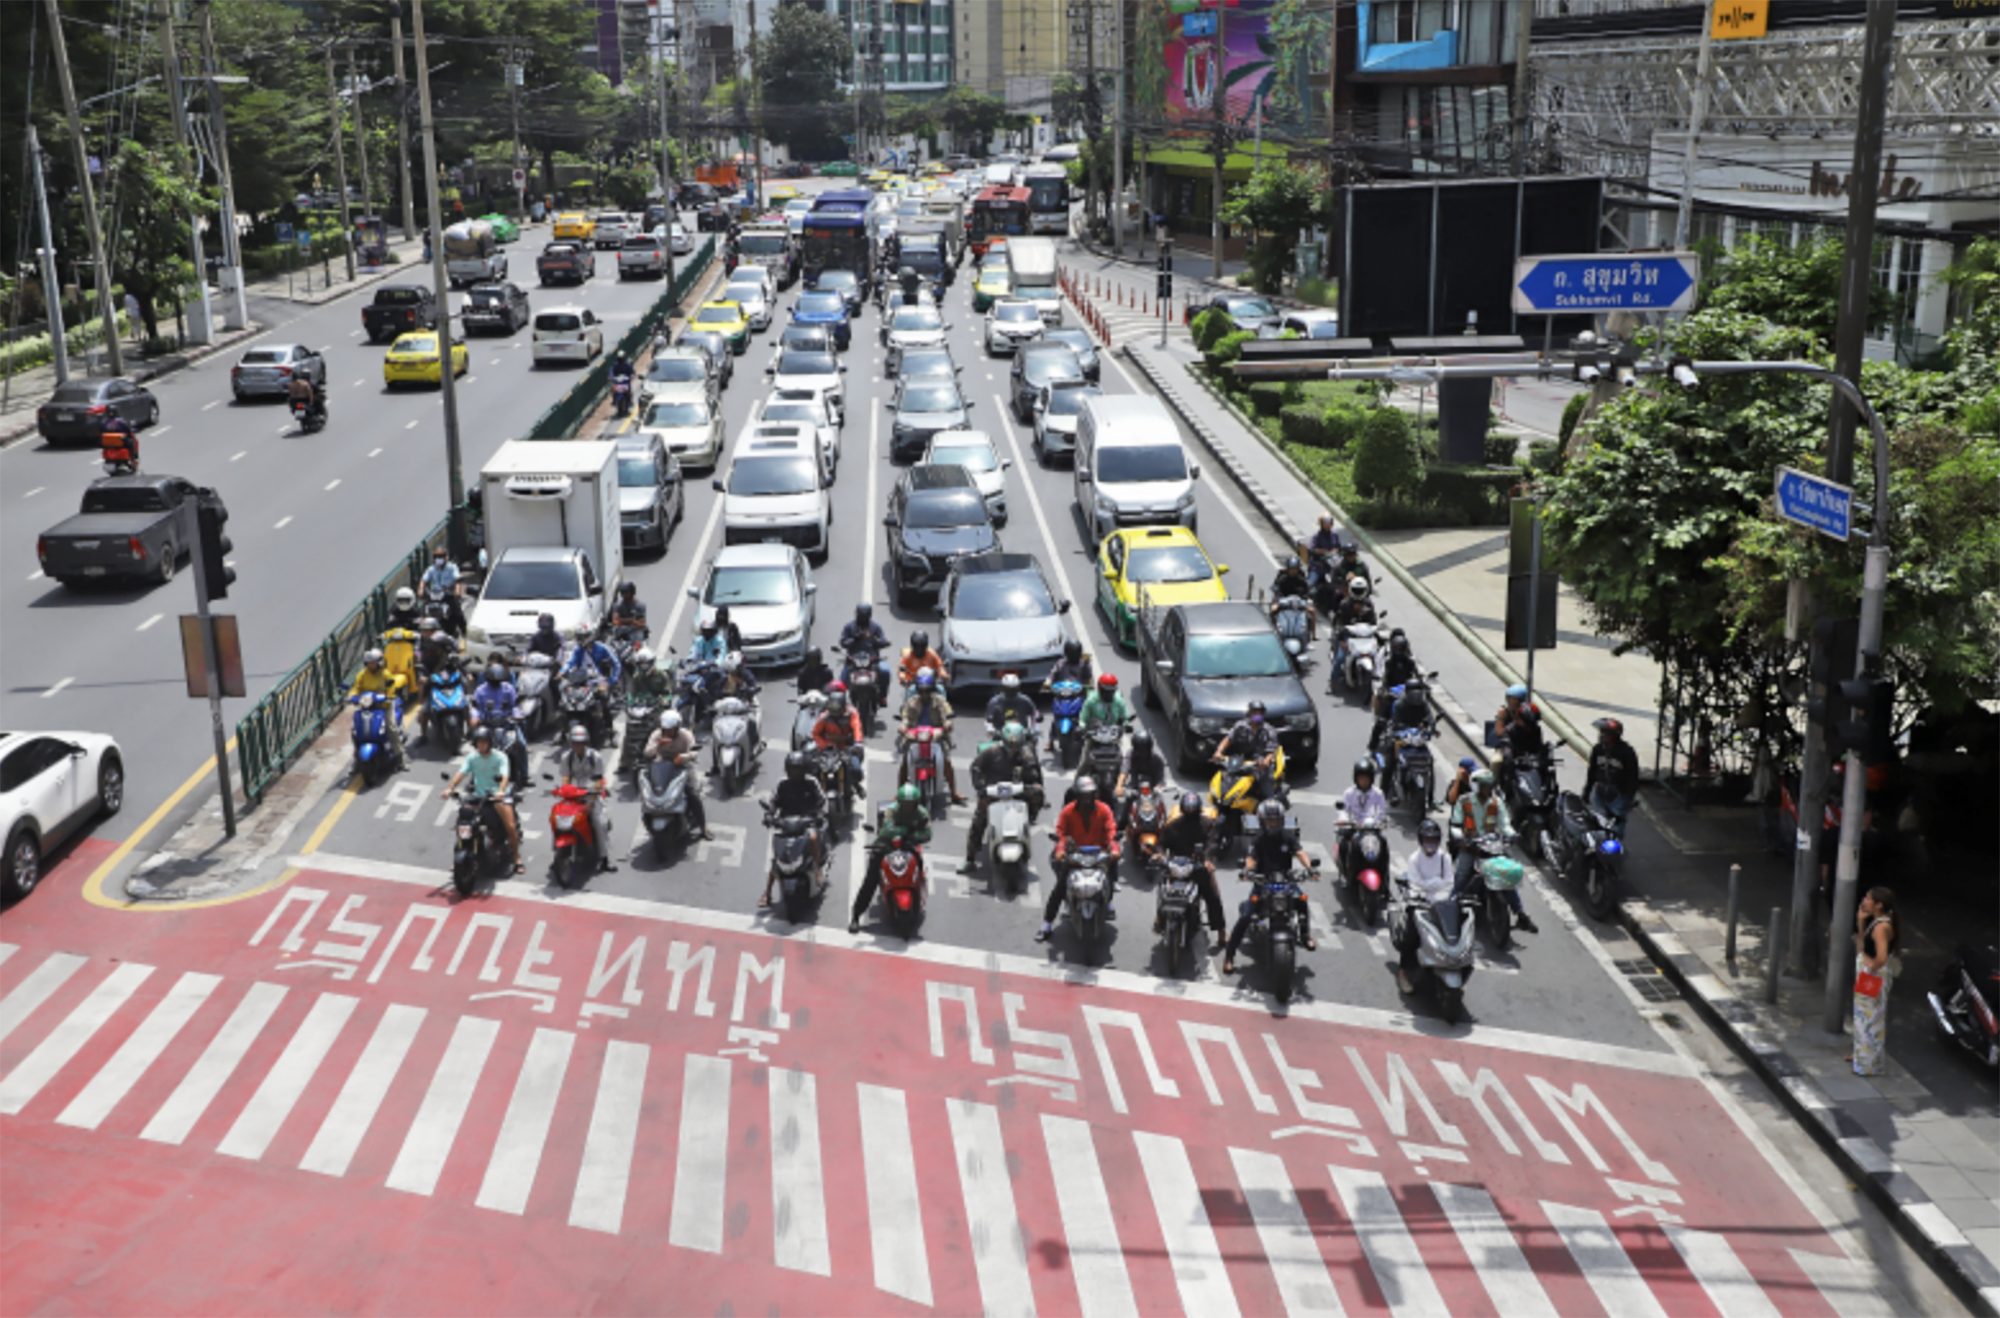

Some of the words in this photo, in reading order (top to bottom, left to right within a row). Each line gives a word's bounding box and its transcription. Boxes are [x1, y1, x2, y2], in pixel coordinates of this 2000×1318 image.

[1717, 6, 1755, 29] yellow
[1583, 261, 1659, 293] สุขุมวิท
[1555, 294, 1622, 306] Sukhumvit
[1632, 292, 1655, 304] Rd.
